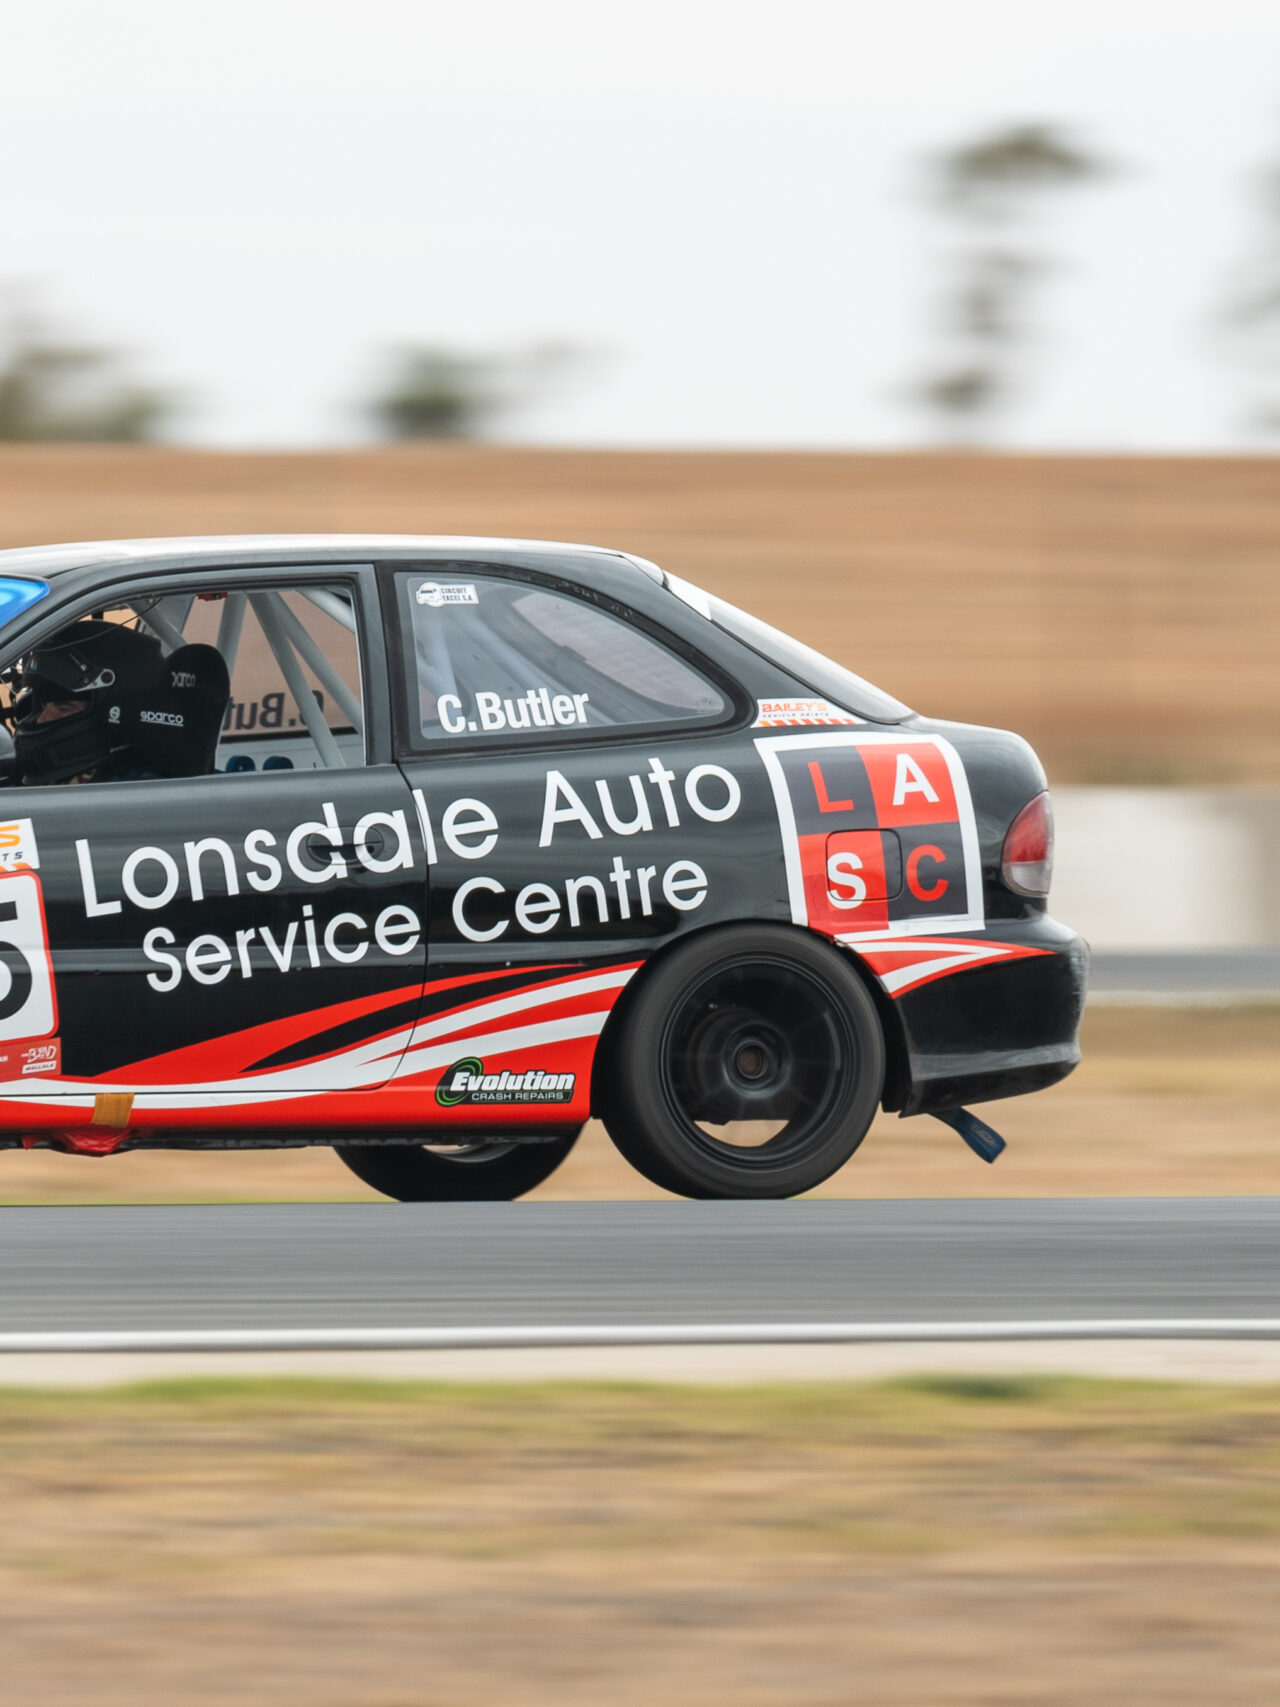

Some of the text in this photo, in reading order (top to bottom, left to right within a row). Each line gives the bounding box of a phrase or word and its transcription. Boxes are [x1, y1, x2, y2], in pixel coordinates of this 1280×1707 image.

[140, 711, 184, 724] sparco
[75, 757, 741, 918] Lonsdale Auto
[142, 856, 708, 992] Service Centre
[450, 1070, 576, 1092] Evolution
[471, 1091, 564, 1101] CRASH REPAIRS
